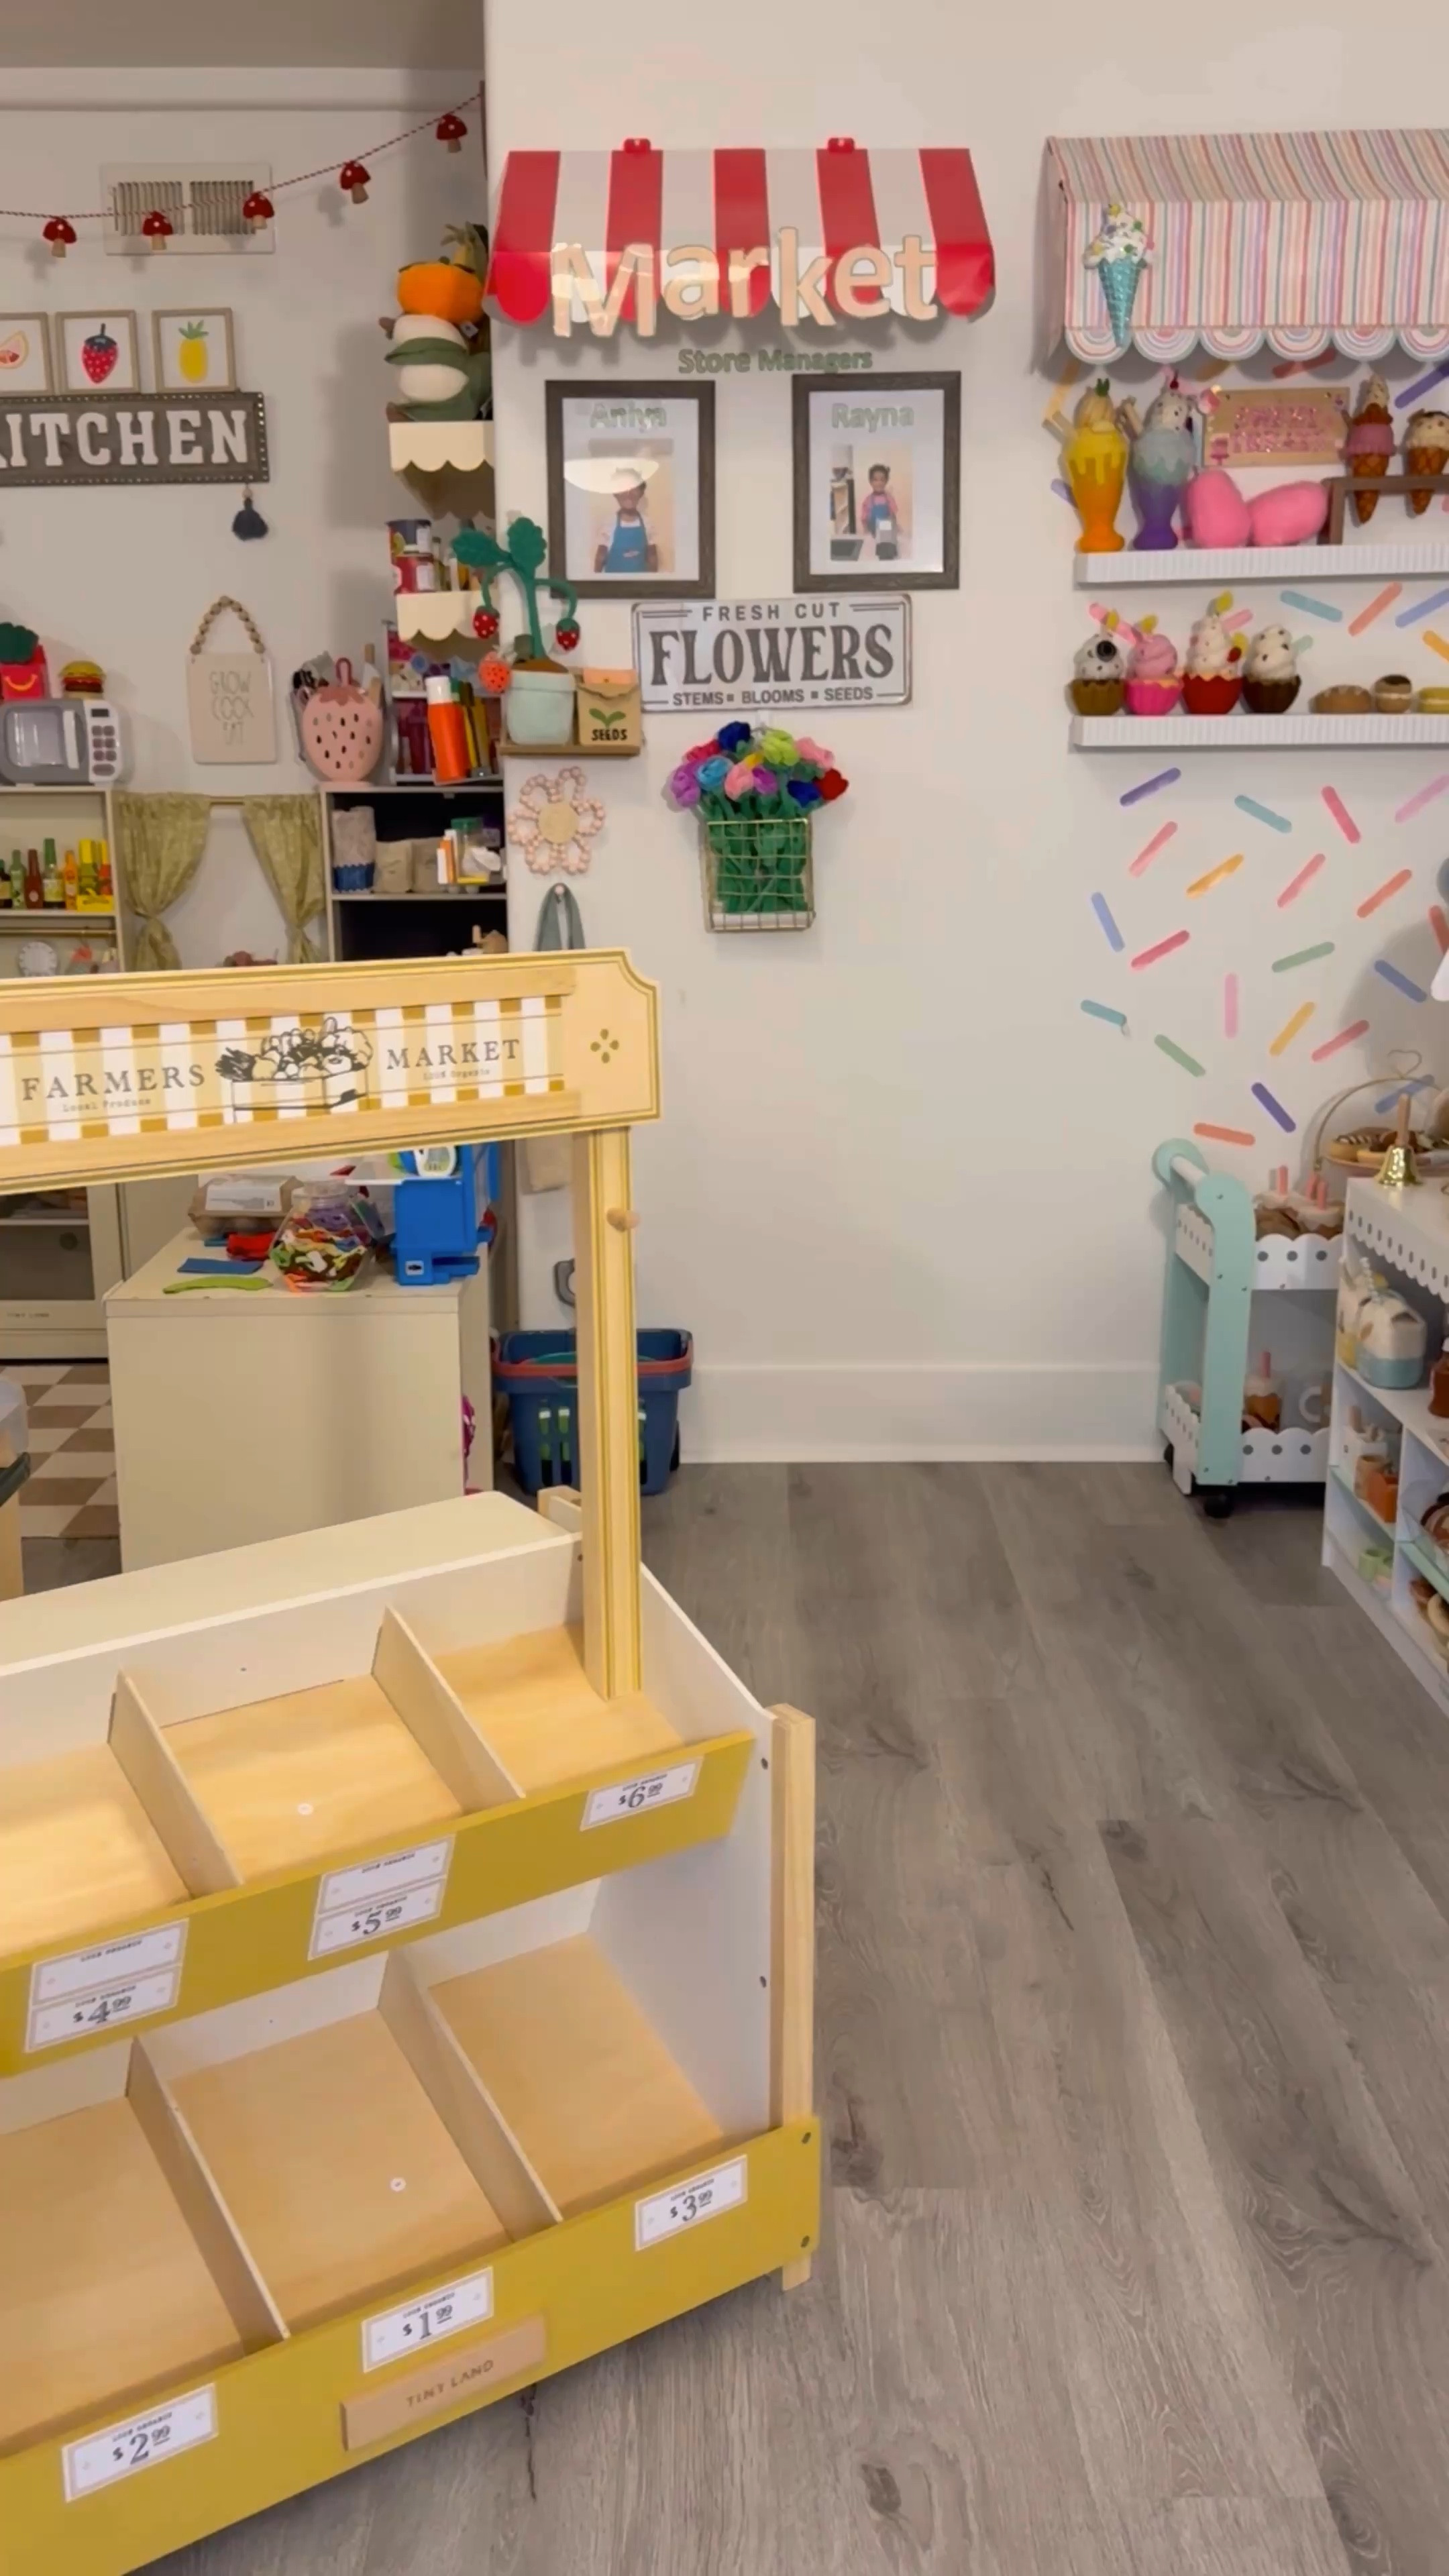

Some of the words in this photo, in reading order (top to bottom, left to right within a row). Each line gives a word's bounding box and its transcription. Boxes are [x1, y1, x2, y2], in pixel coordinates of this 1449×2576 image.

[550, 227, 938, 337] Market
[678, 349, 751, 374] Store
[758, 348, 873, 374] Managers
[0, 410, 249, 469] ITCHEN
[702, 604, 780, 621] FRESH
[795, 602, 841, 619] CUT
[649, 623, 894, 686] FLOWERS
[672, 692, 724, 706] STEMS
[741, 690, 804, 704] BLOOMS
[824, 686, 873, 702] SEEDS
[591, 728, 628, 741] SEEDS
[21, 1064, 205, 1101] FARMERS
[386, 1038, 519, 1070] MARKET
[406, 2383, 445, 2408] TINY
[450, 2359, 494, 2388] LAND
